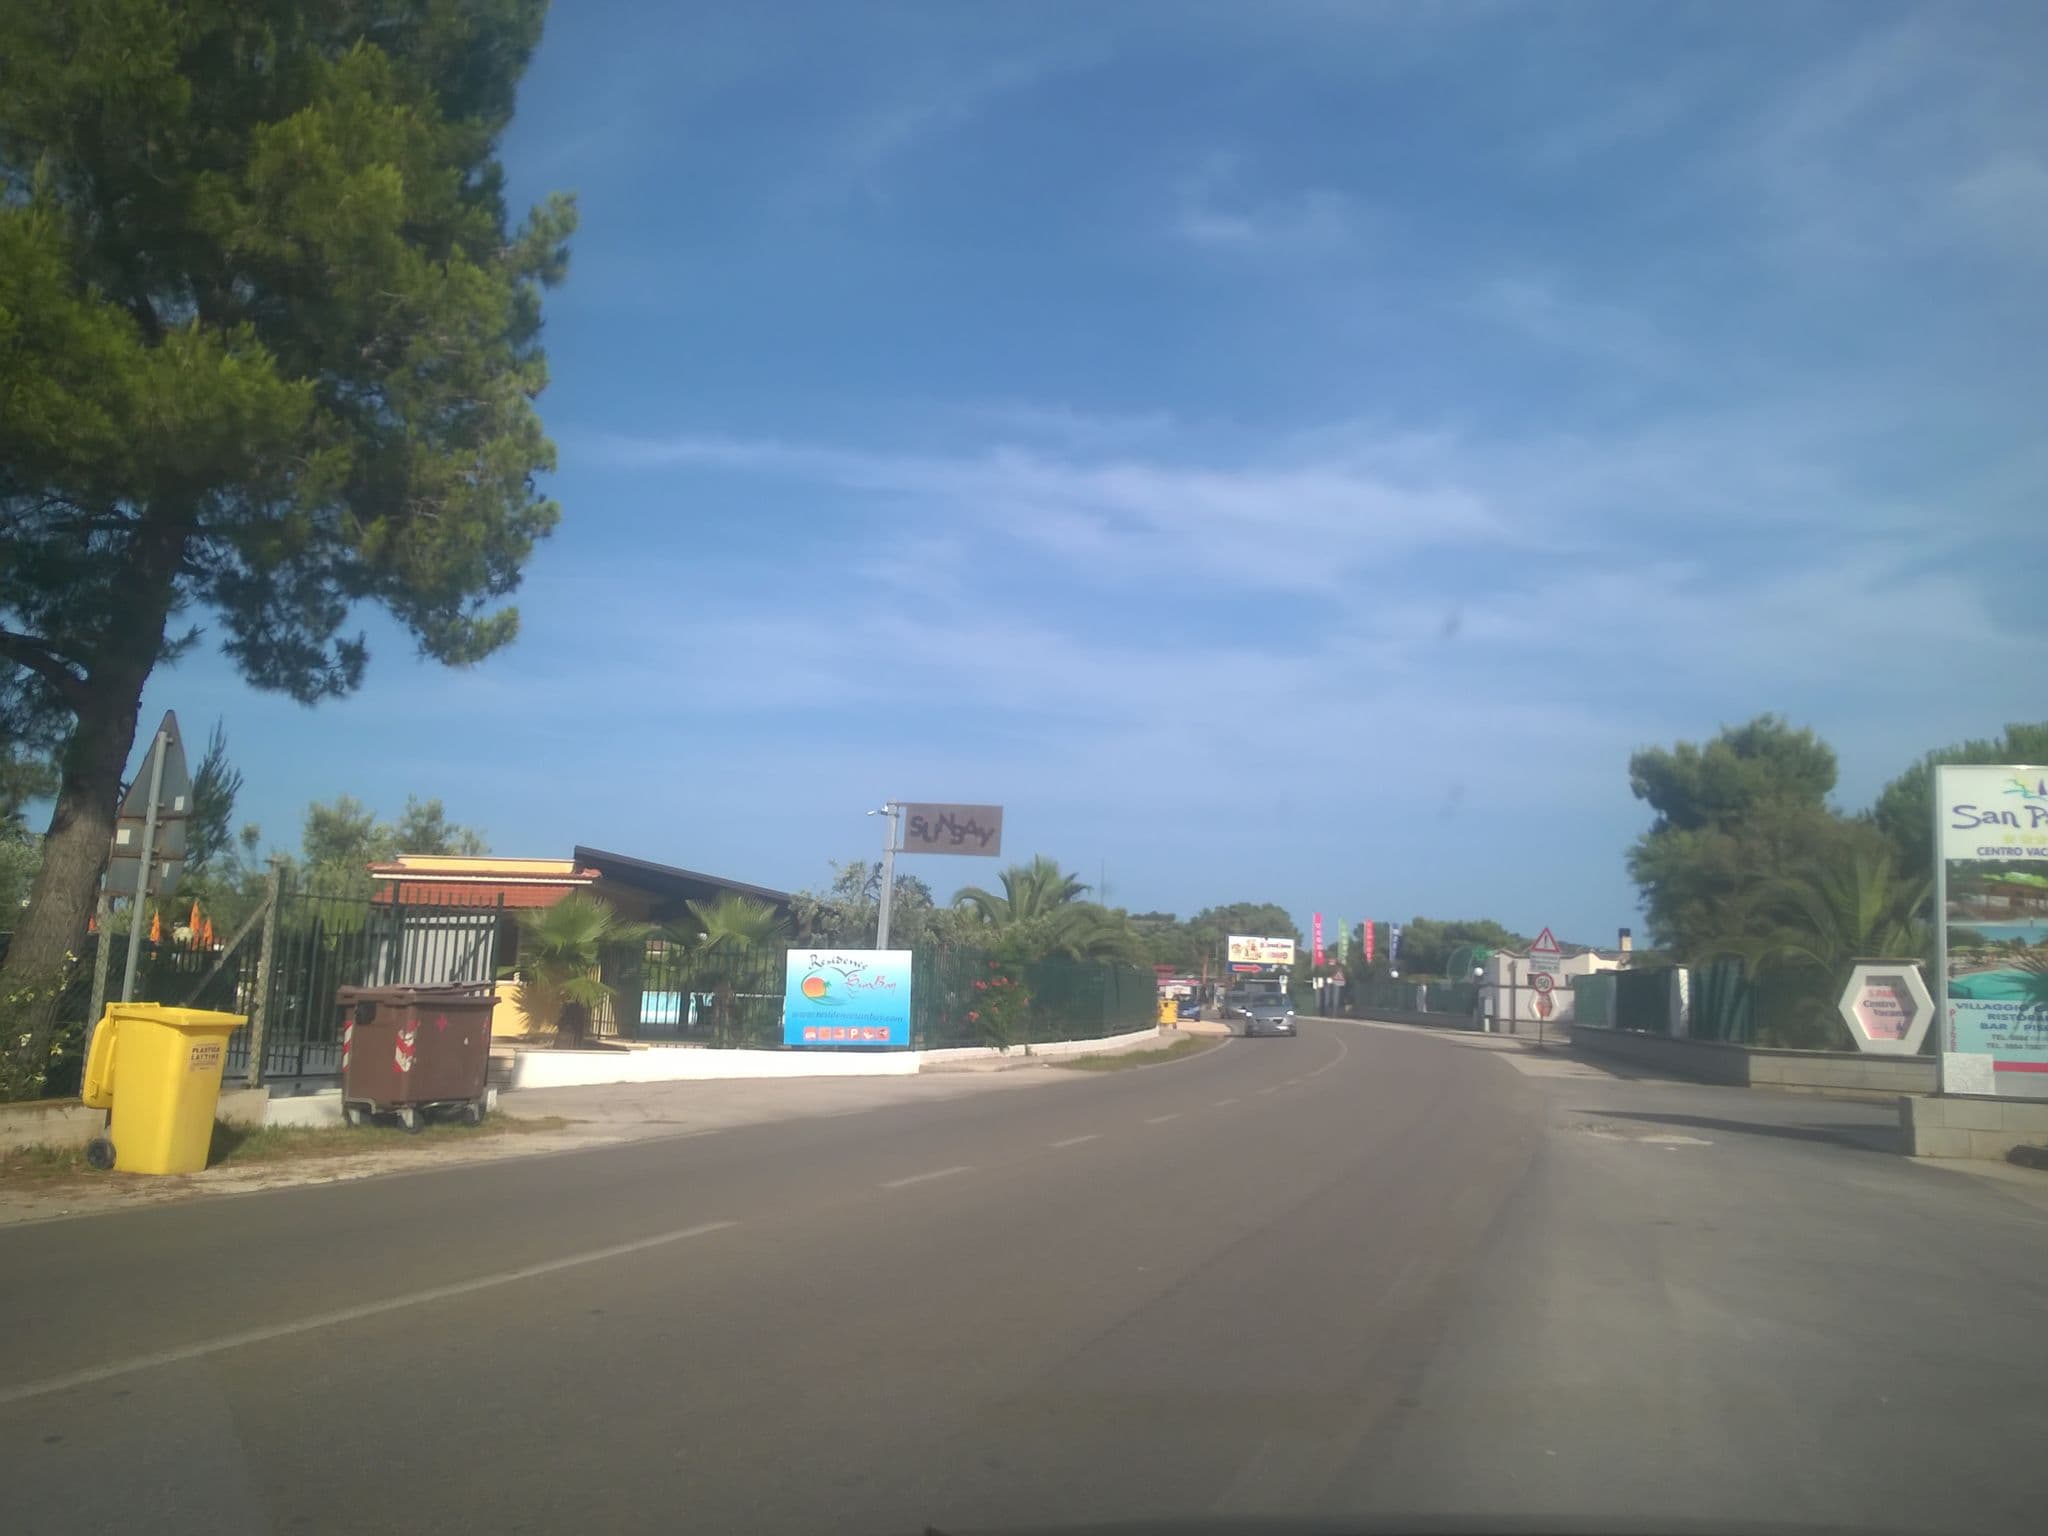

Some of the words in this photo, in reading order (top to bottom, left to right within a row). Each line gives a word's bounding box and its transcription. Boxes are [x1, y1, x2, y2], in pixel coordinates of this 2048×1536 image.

[1951, 804, 2021, 829] San
[1976, 847, 2023, 856] CENTRO
[1956, 1003, 2029, 1012] VILLAGGIO
